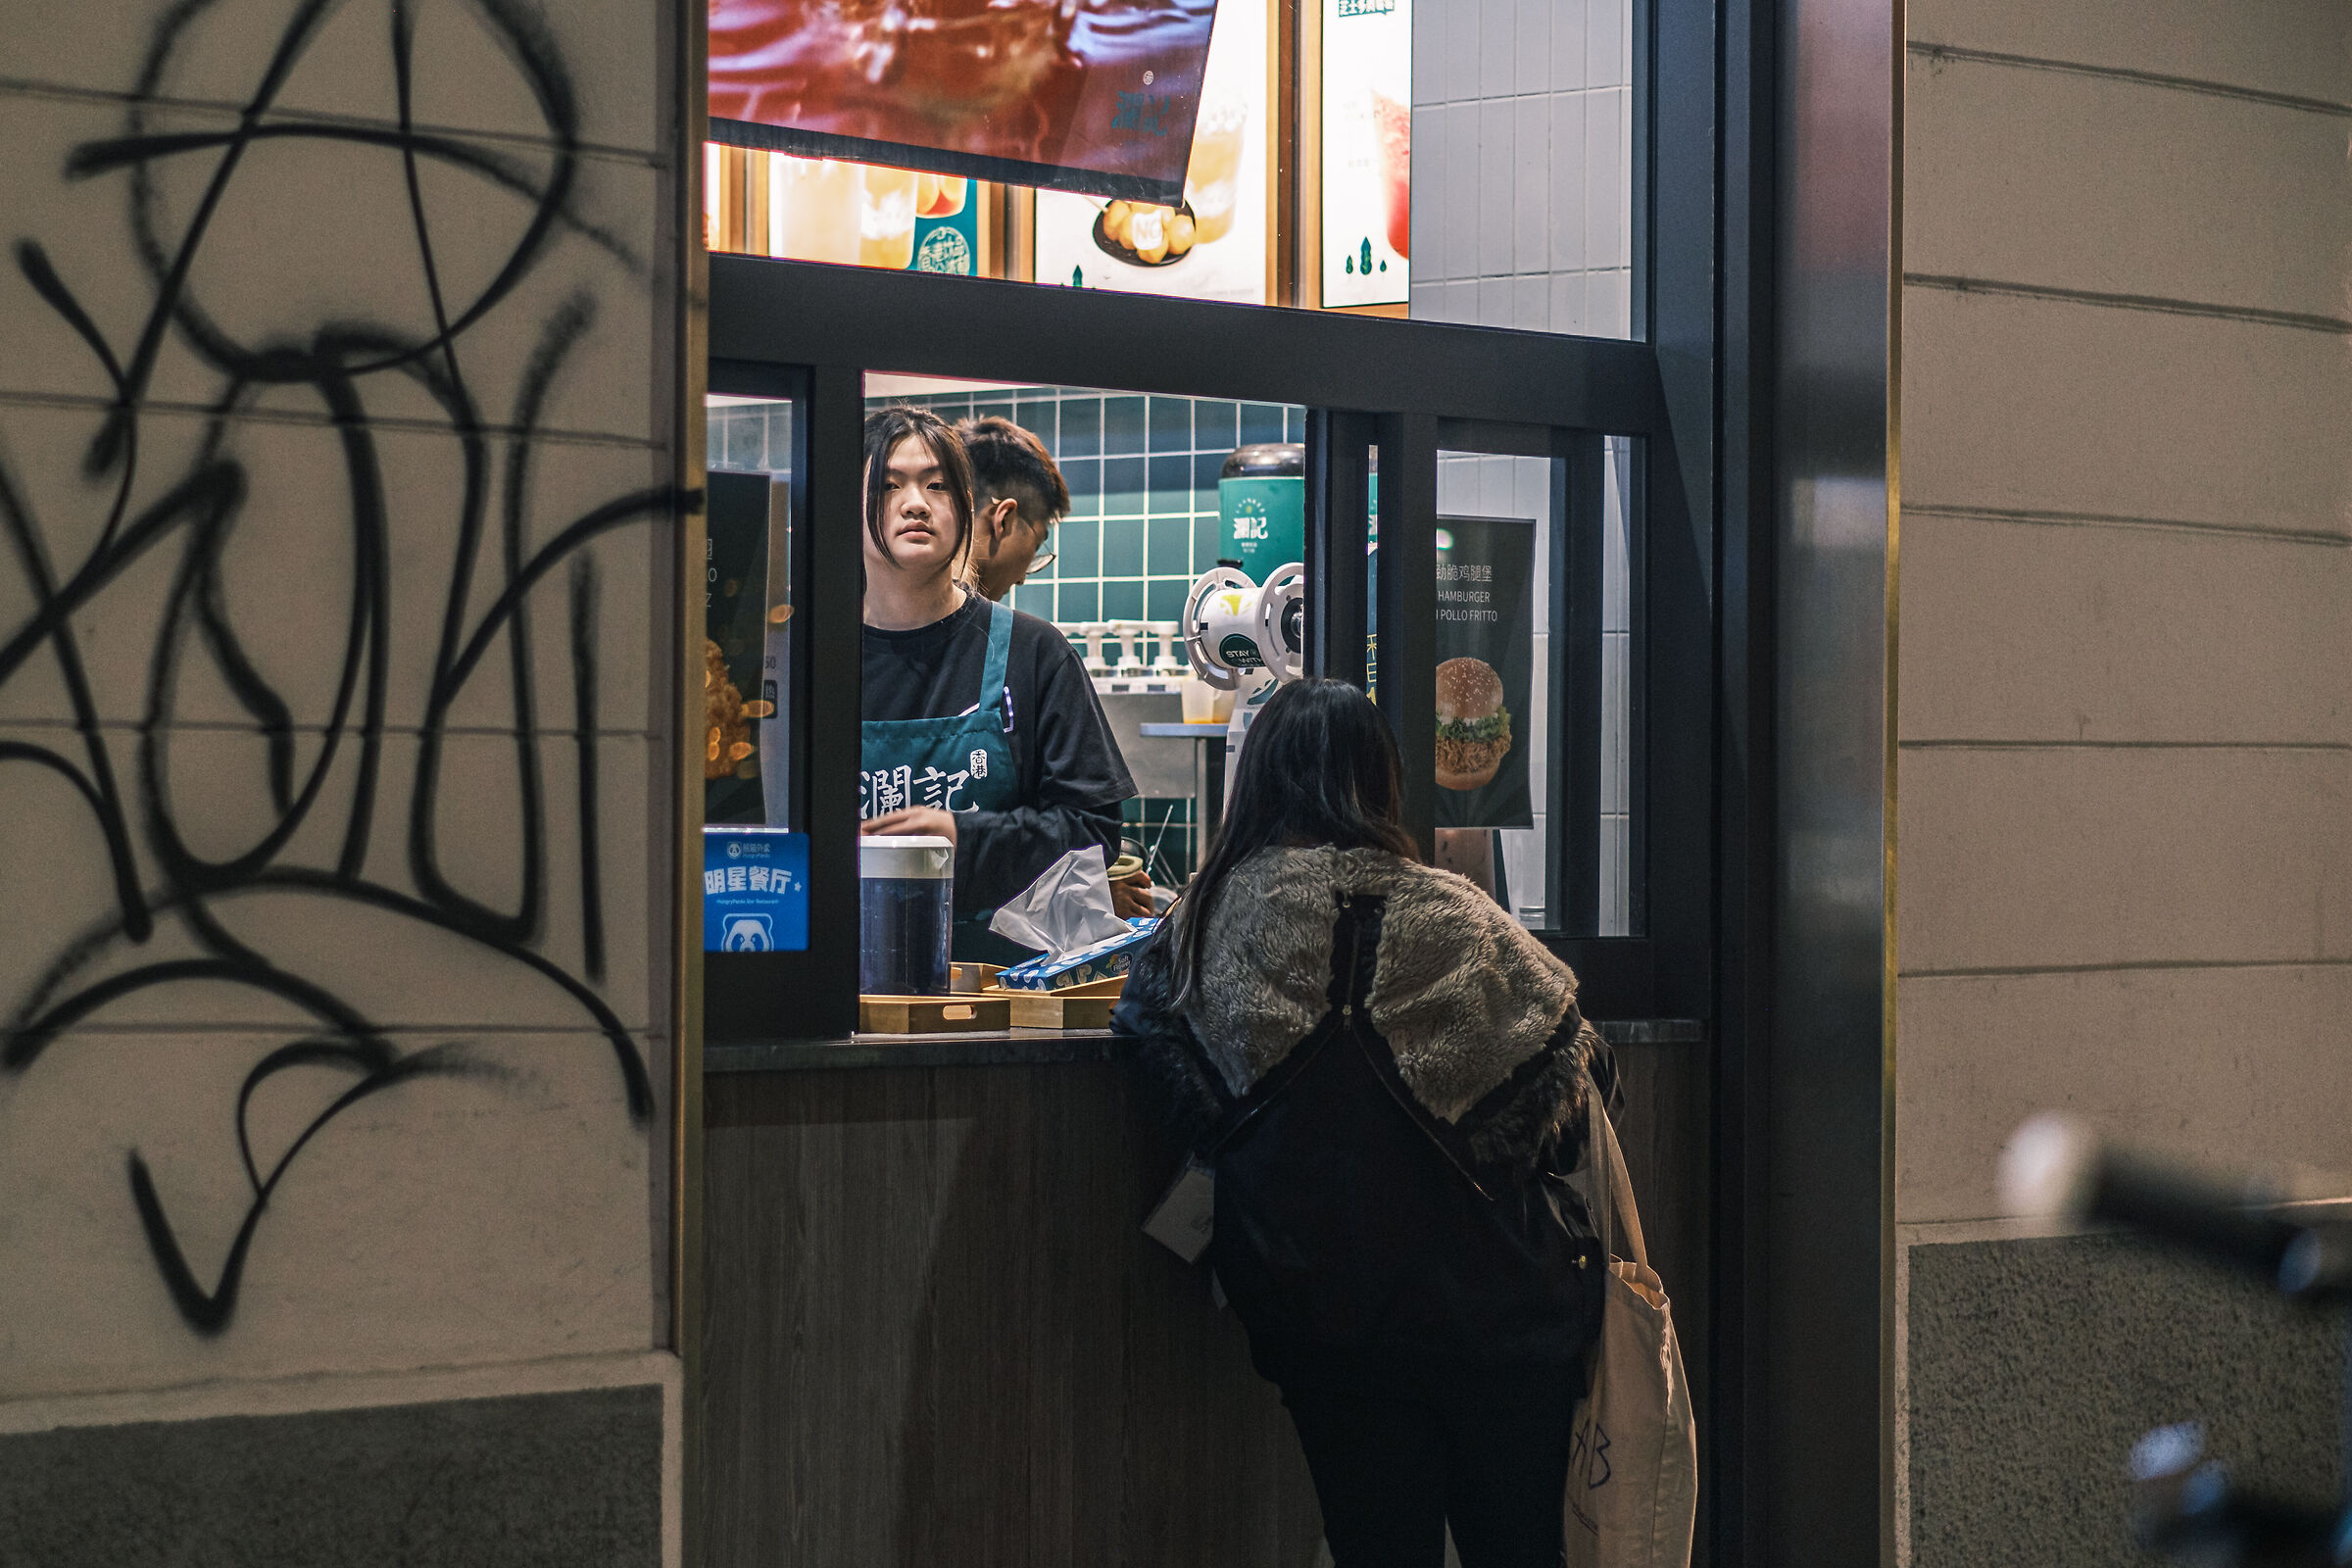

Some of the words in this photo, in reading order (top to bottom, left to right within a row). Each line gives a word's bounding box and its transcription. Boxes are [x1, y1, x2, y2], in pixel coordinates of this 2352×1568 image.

[1438, 590, 1490, 603] HAMBURGER
[1440, 609, 1468, 621] POLLO
[1469, 610, 1498, 622] FRITTO
[1225, 650, 1250, 659] STAY
[971, 750, 986, 778] 香港
[704, 865, 792, 895] 明星餐厅
